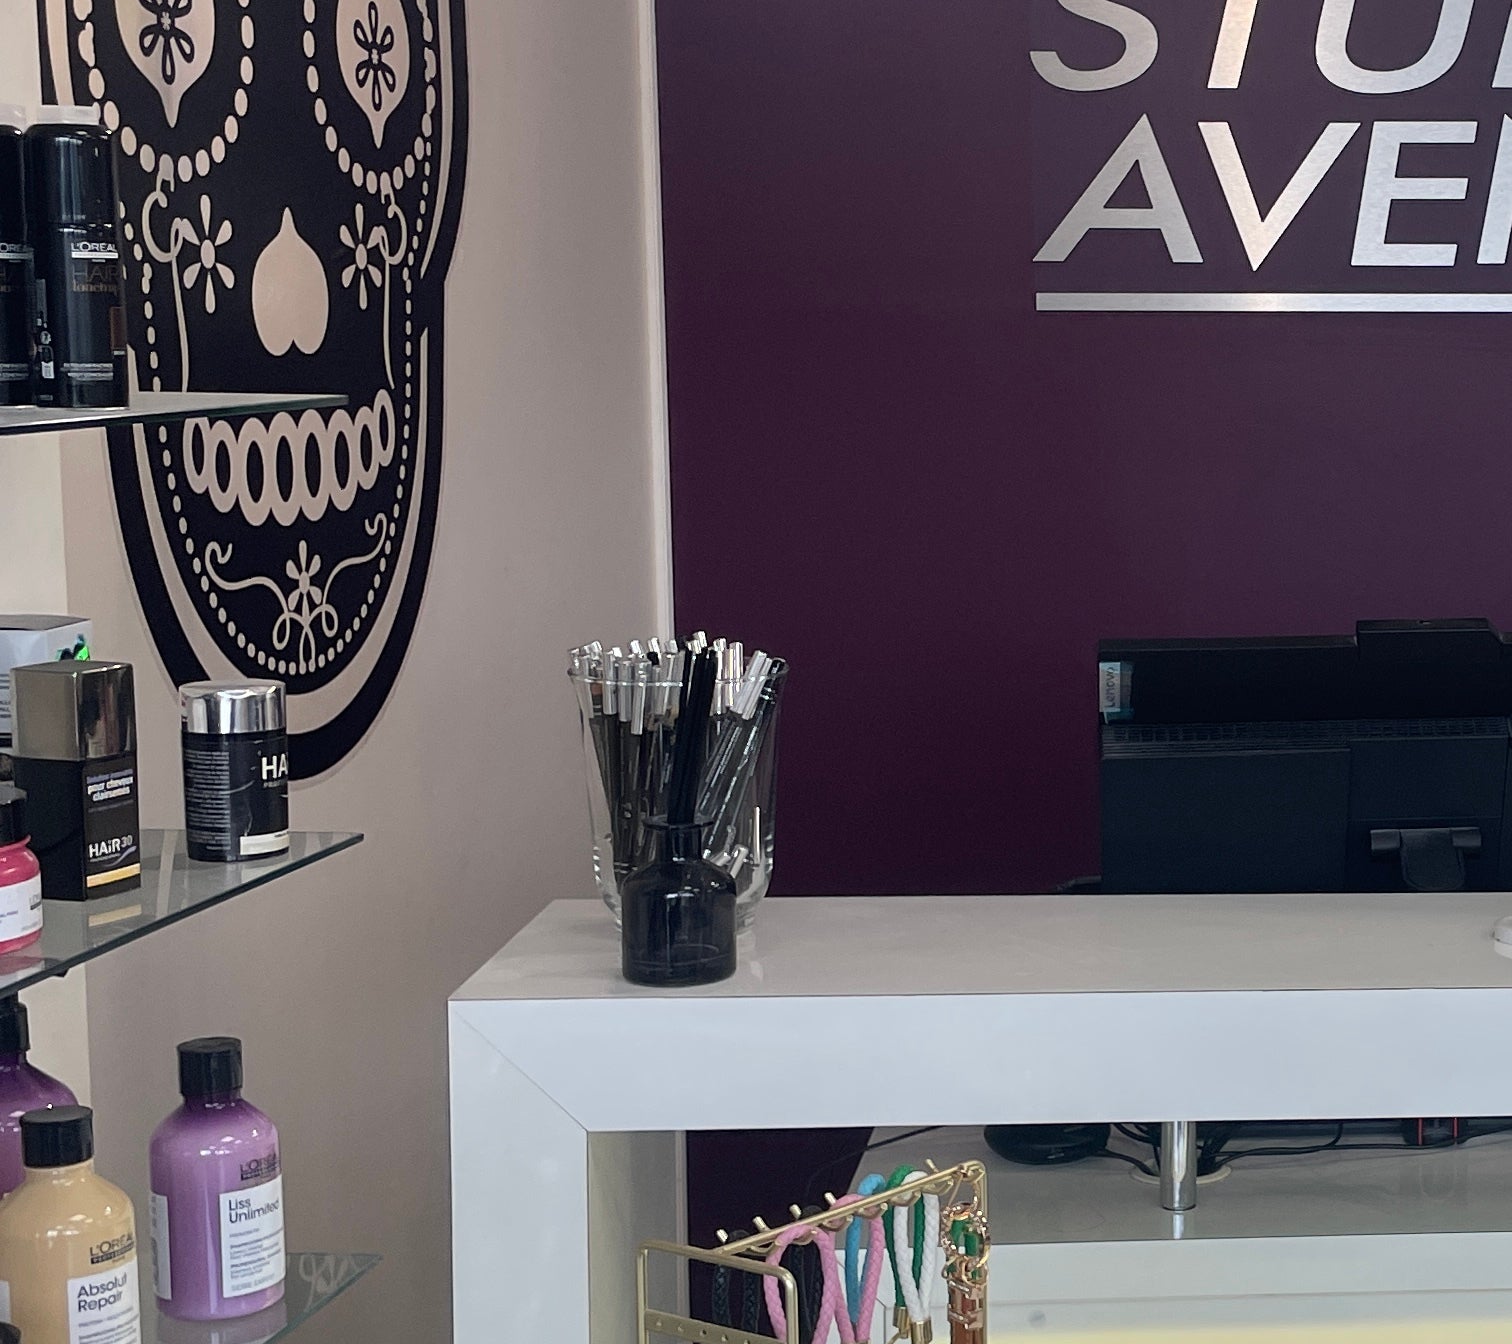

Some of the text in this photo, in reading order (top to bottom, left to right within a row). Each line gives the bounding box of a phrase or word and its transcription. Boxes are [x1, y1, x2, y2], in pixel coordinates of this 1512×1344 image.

[228, 1198, 252, 1211] Liss
[229, 1198, 281, 1224] Unlimited
[77, 1271, 128, 1299] Absolut
[77, 1290, 123, 1313] Repair
